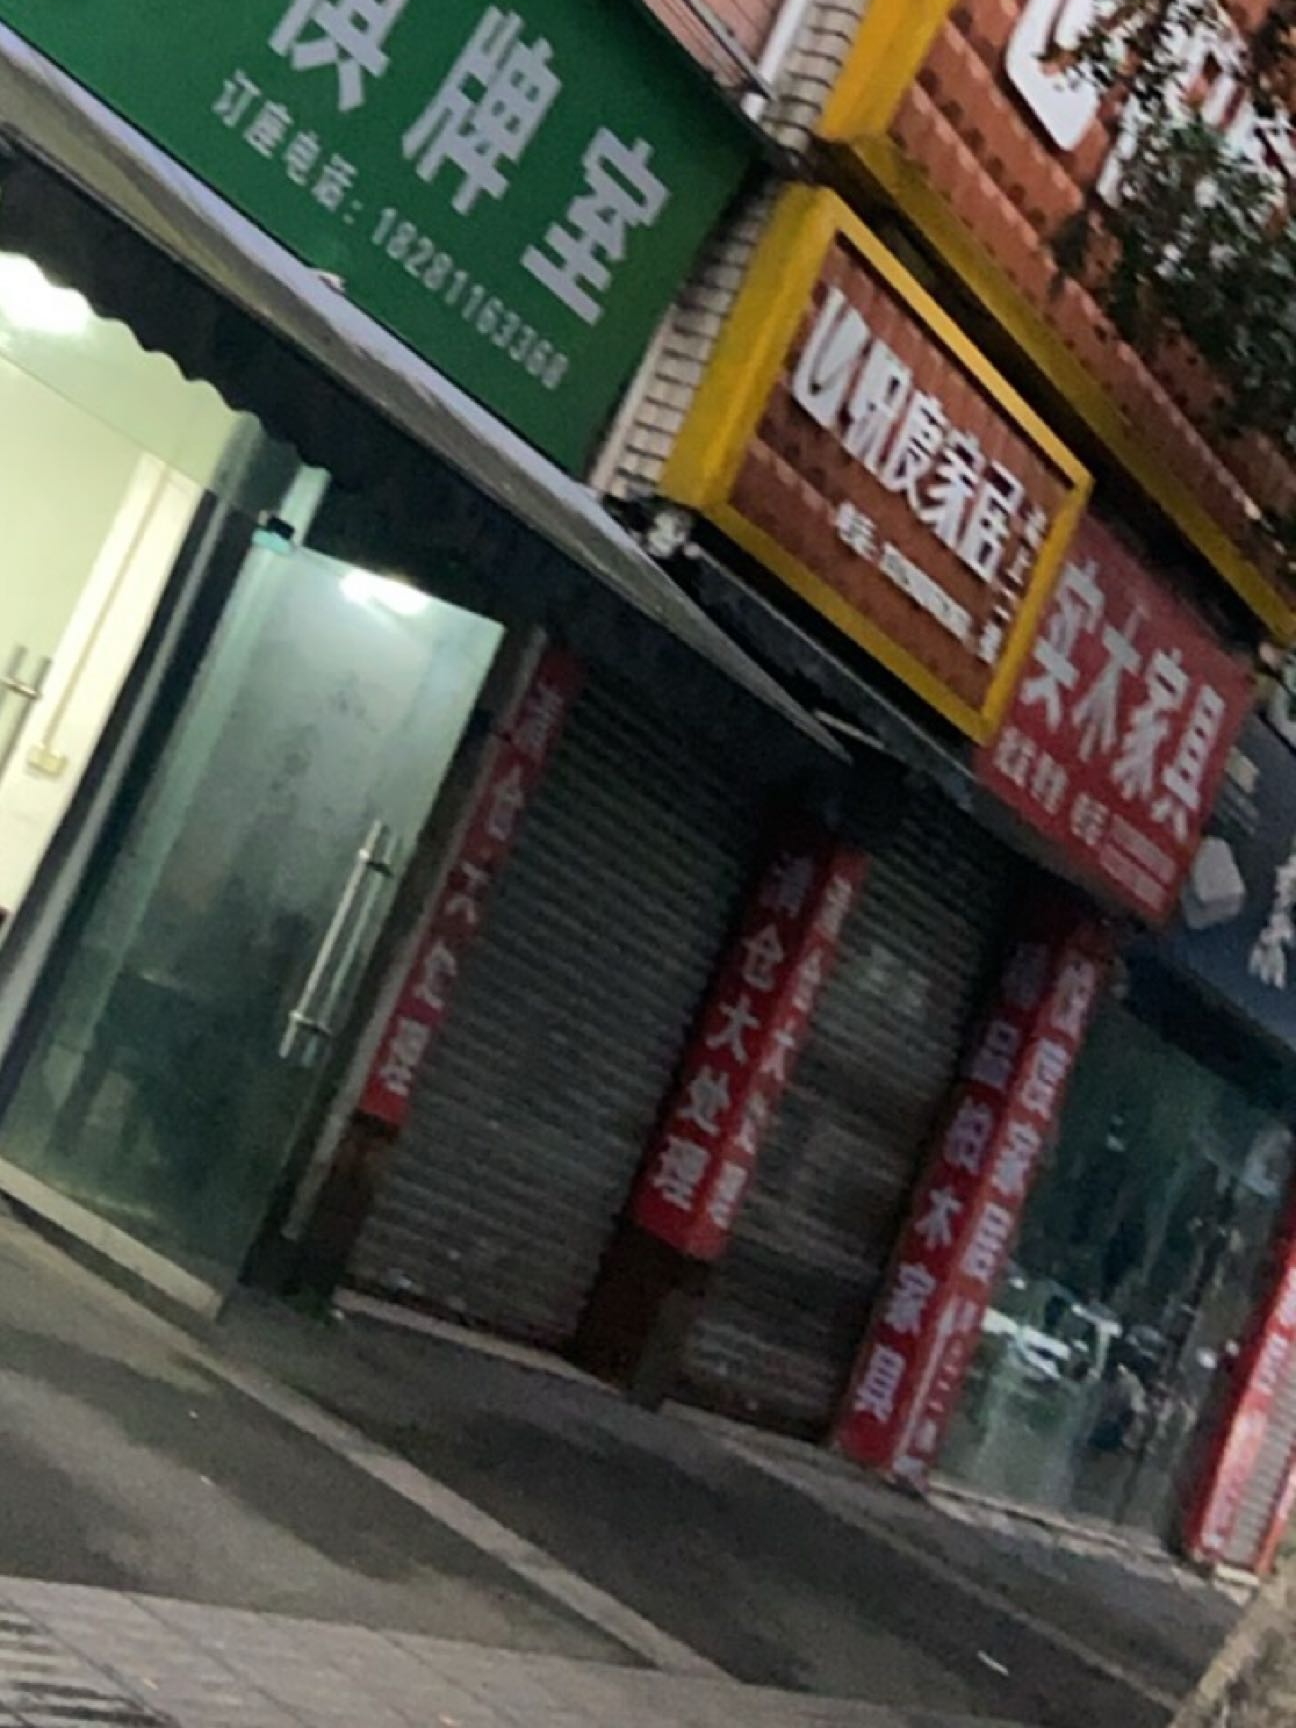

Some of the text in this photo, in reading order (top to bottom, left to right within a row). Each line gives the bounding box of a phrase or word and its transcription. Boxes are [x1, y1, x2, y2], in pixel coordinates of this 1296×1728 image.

[1021, 560, 1225, 843] 实木家具
[653, 852, 814, 1210] 清仓大处理
